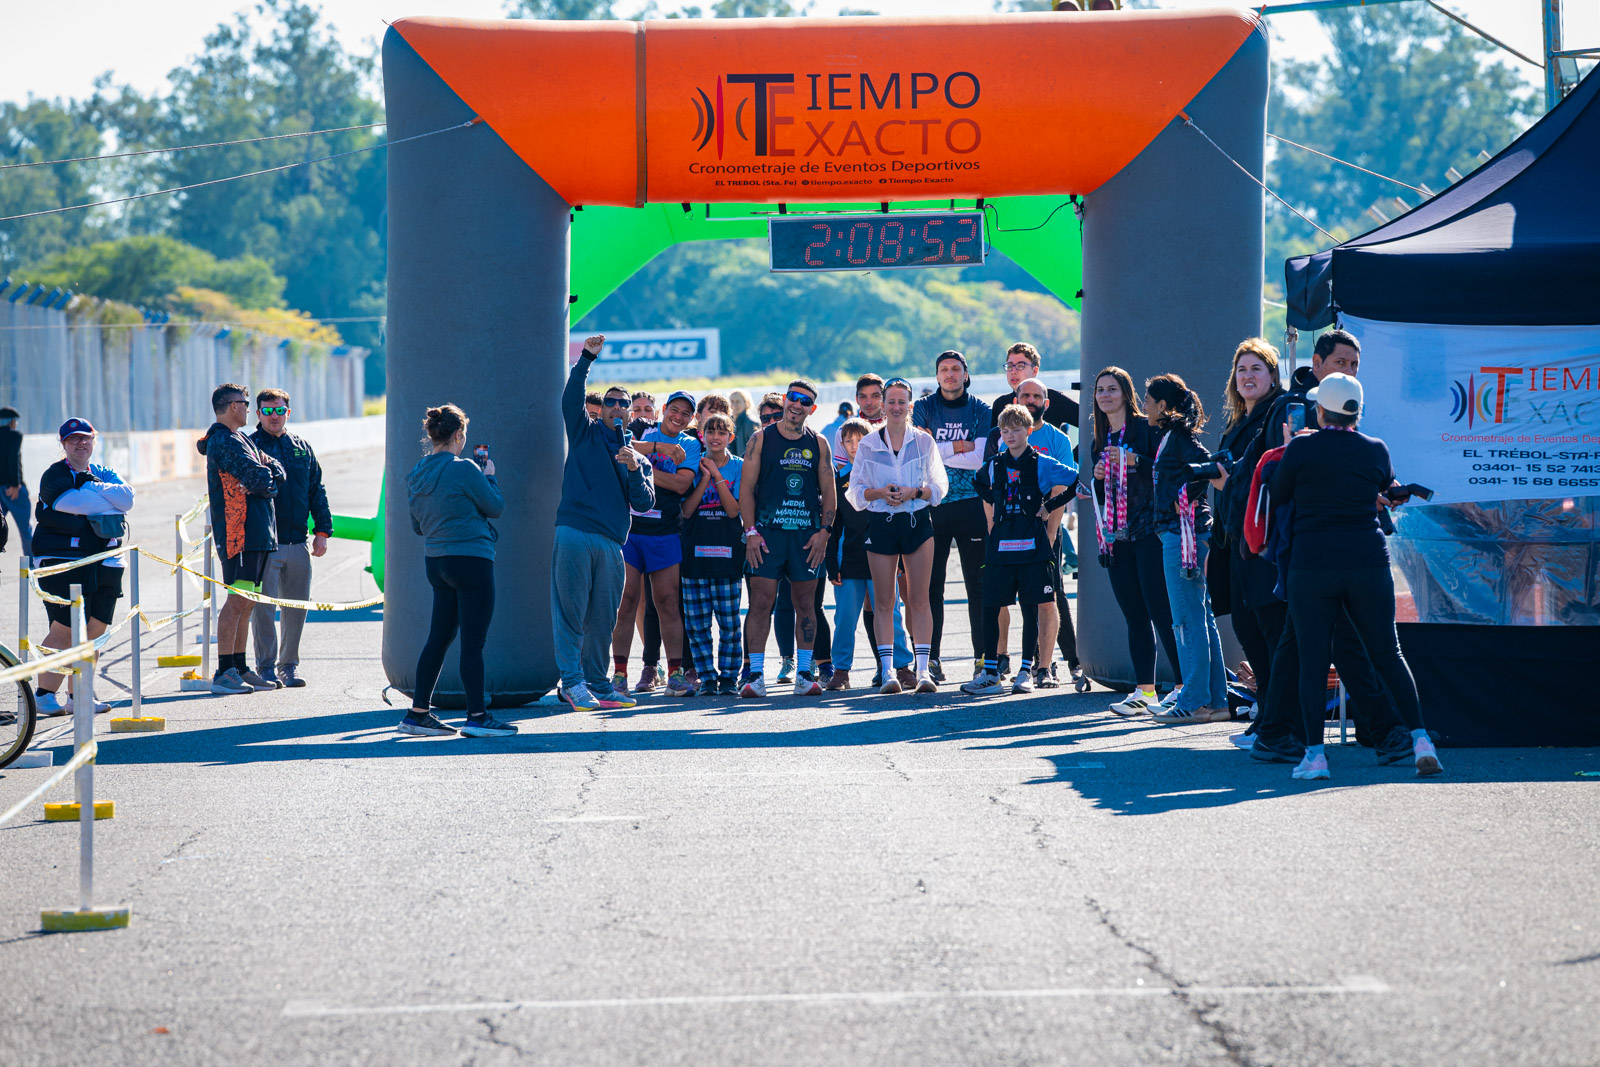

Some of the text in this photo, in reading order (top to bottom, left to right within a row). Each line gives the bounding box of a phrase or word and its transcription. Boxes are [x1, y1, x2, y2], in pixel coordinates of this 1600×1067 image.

[769, 85, 981, 157] EXACTO
[689, 160, 980, 176] Cronometraje de Eventos Deportivos
[784, 179, 797, 187] Fe)
[804, 218, 977, 266] 2:08:52
[936, 428, 969, 440] RUN
[1441, 433, 1514, 445] Cronometraje
[1517, 434, 1531, 443] de
[1534, 434, 1578, 444] Eventos
[804, 450, 811, 459] 3
[1463, 449, 1483, 458] EL
[1472, 463, 1522, 472] 03401-
[1526, 464, 1542, 473] 15
[1546, 464, 1566, 473] 52
[1468, 477, 1600, 487] 0341- 15 68 6655
[782, 500, 805, 508] MEDIA
[773, 518, 811, 526] NOCTURNA
